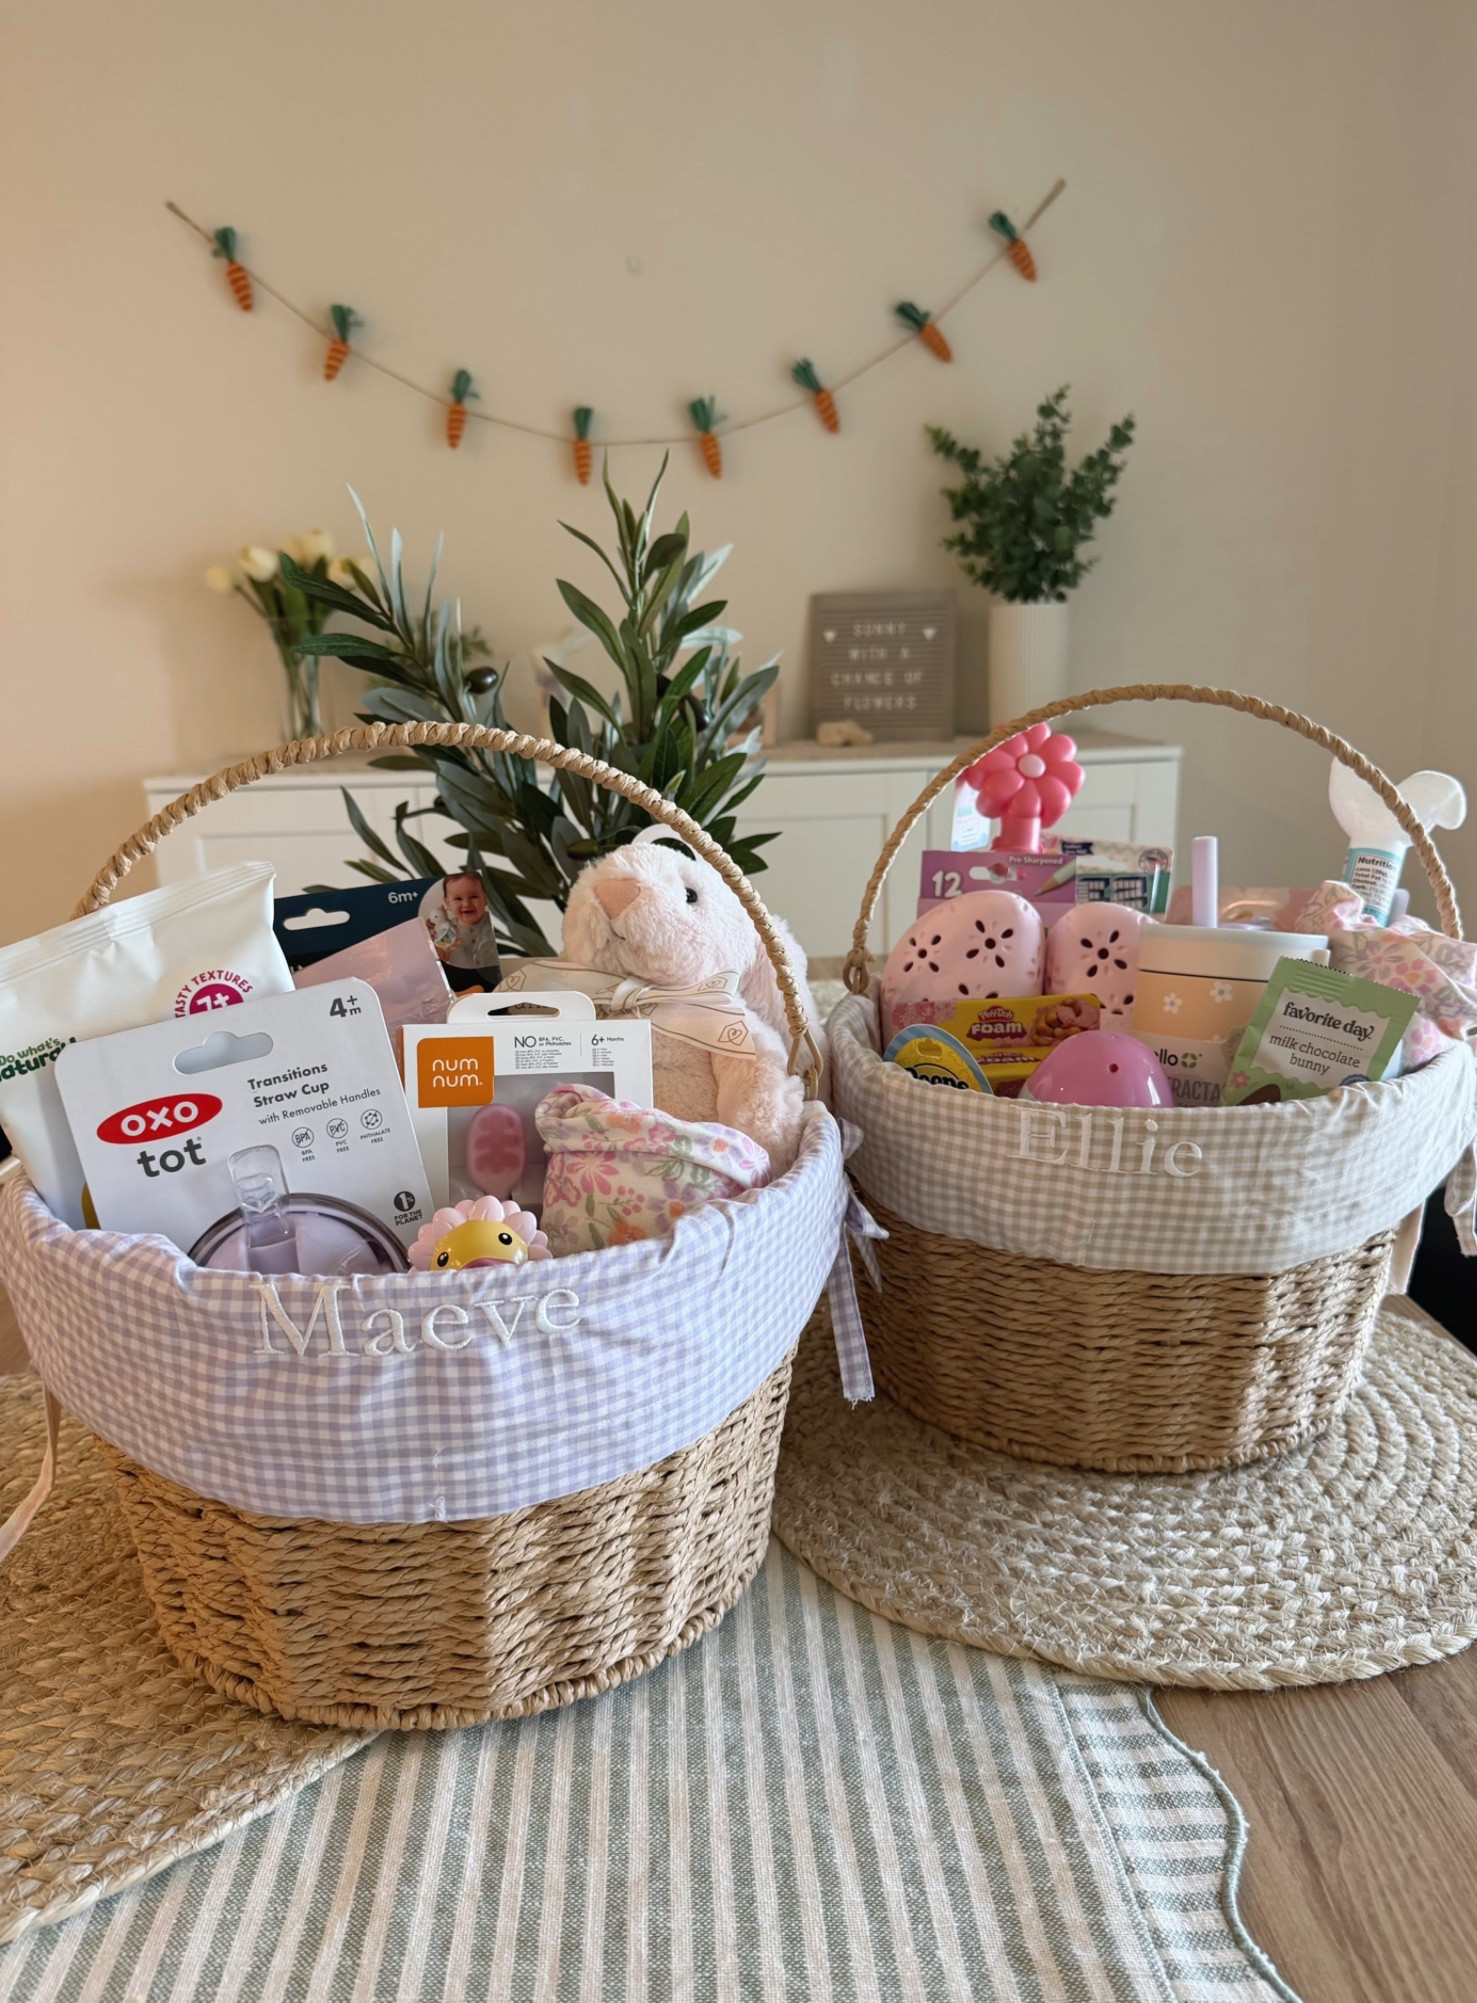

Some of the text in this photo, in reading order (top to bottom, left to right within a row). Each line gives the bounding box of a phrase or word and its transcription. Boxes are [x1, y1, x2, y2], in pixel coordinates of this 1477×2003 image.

[1008, 855, 1063, 865] Pre-Sharpened
[932, 870, 962, 898] 12
[191, 969, 254, 993] TEXTURES
[1282, 1001, 1341, 1030] favorite
[17, 1037, 61, 1059] what's
[514, 1035, 537, 1048] NO
[591, 1034, 605, 1046] 6+
[1269, 1035, 1361, 1068] milk chocolate
[247, 1063, 329, 1090] Transitions
[432, 1058, 479, 1072] num
[1289, 1052, 1330, 1076] bunny
[253, 1081, 330, 1108] Straw Cup
[258, 1087, 381, 1125] with Removable Handles
[121, 1101, 199, 1137] OXO
[336, 1145, 350, 1154] FREE
[1007, 1103, 1202, 1177] Ellie
[137, 1138, 207, 1178] tot
[302, 1154, 316, 1163] FREE
[395, 1213, 423, 1226] PLANET
[249, 1283, 582, 1357] Maeve
